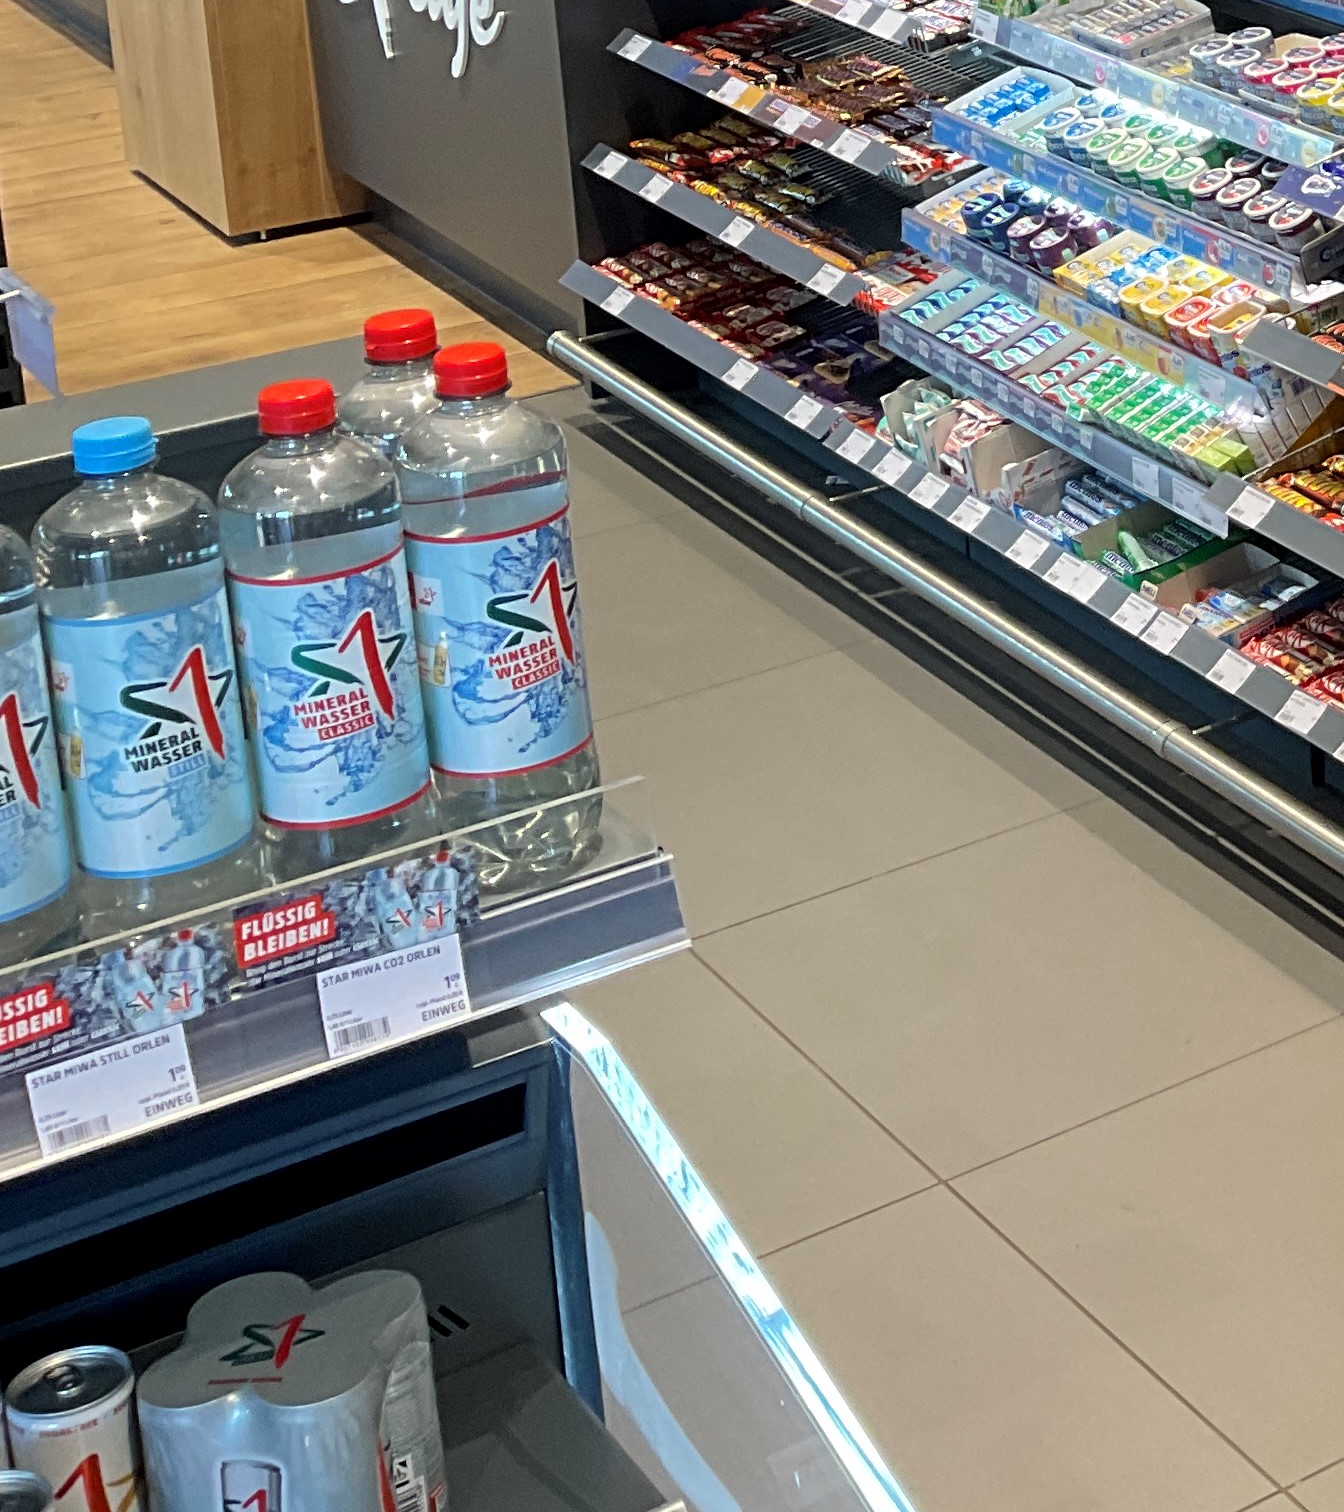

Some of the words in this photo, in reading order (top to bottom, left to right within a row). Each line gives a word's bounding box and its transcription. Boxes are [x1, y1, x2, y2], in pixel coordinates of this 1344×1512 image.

[488, 638, 556, 667] MINERAL
[495, 649, 558, 680] WASSER
[514, 660, 560, 688] CLASSIC
[293, 689, 368, 716] MINERAL
[301, 701, 371, 729] WASSER
[320, 715, 374, 739] CLASSIC
[124, 728, 200, 760] MINERAL
[131, 740, 203, 773] WASSER
[241, 901, 316, 941] FLÜSSIG
[244, 918, 329, 961] BLEIBEN!
[322, 973, 349, 988] STAR
[351, 964, 382, 979] MIWA
[384, 957, 404, 969] CO2
[406, 946, 440, 963] ORLEN
[421, 1001, 466, 1022] EINWEG
[31, 1071, 61, 1089] STAR
[64, 1060, 98, 1078] MIWA
[99, 1050, 129, 1066] STILL
[132, 1034, 170, 1054] ORLEN
[145, 1092, 193, 1118] EINWEG
